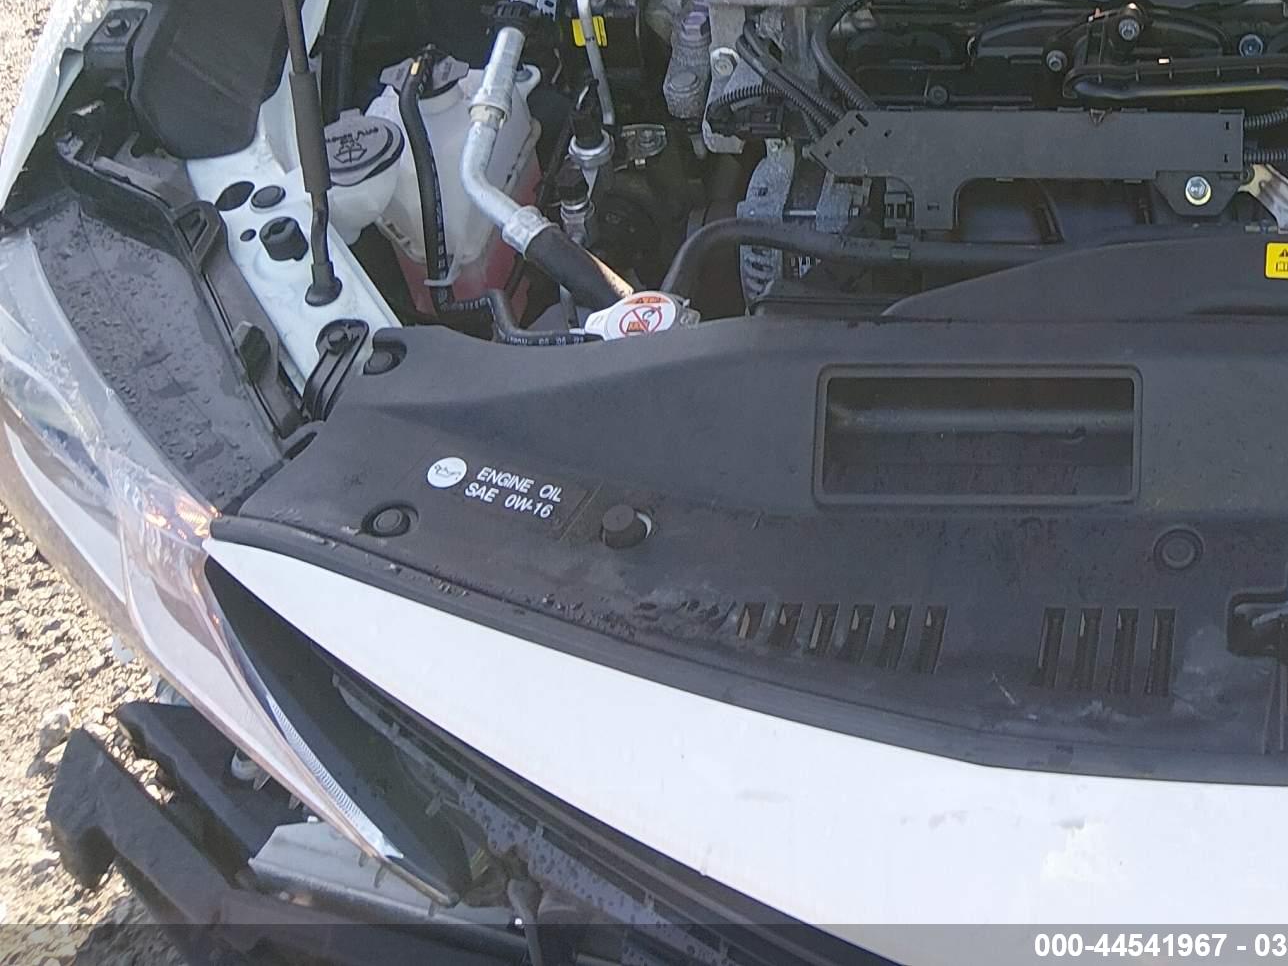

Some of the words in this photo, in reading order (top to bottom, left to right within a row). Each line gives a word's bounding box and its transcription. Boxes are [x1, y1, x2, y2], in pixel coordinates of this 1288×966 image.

[465, 482, 499, 503] SAE
[504, 494, 553, 518] 0W-16
[477, 466, 534, 493] ENGINE
[539, 484, 563, 502] OIL
